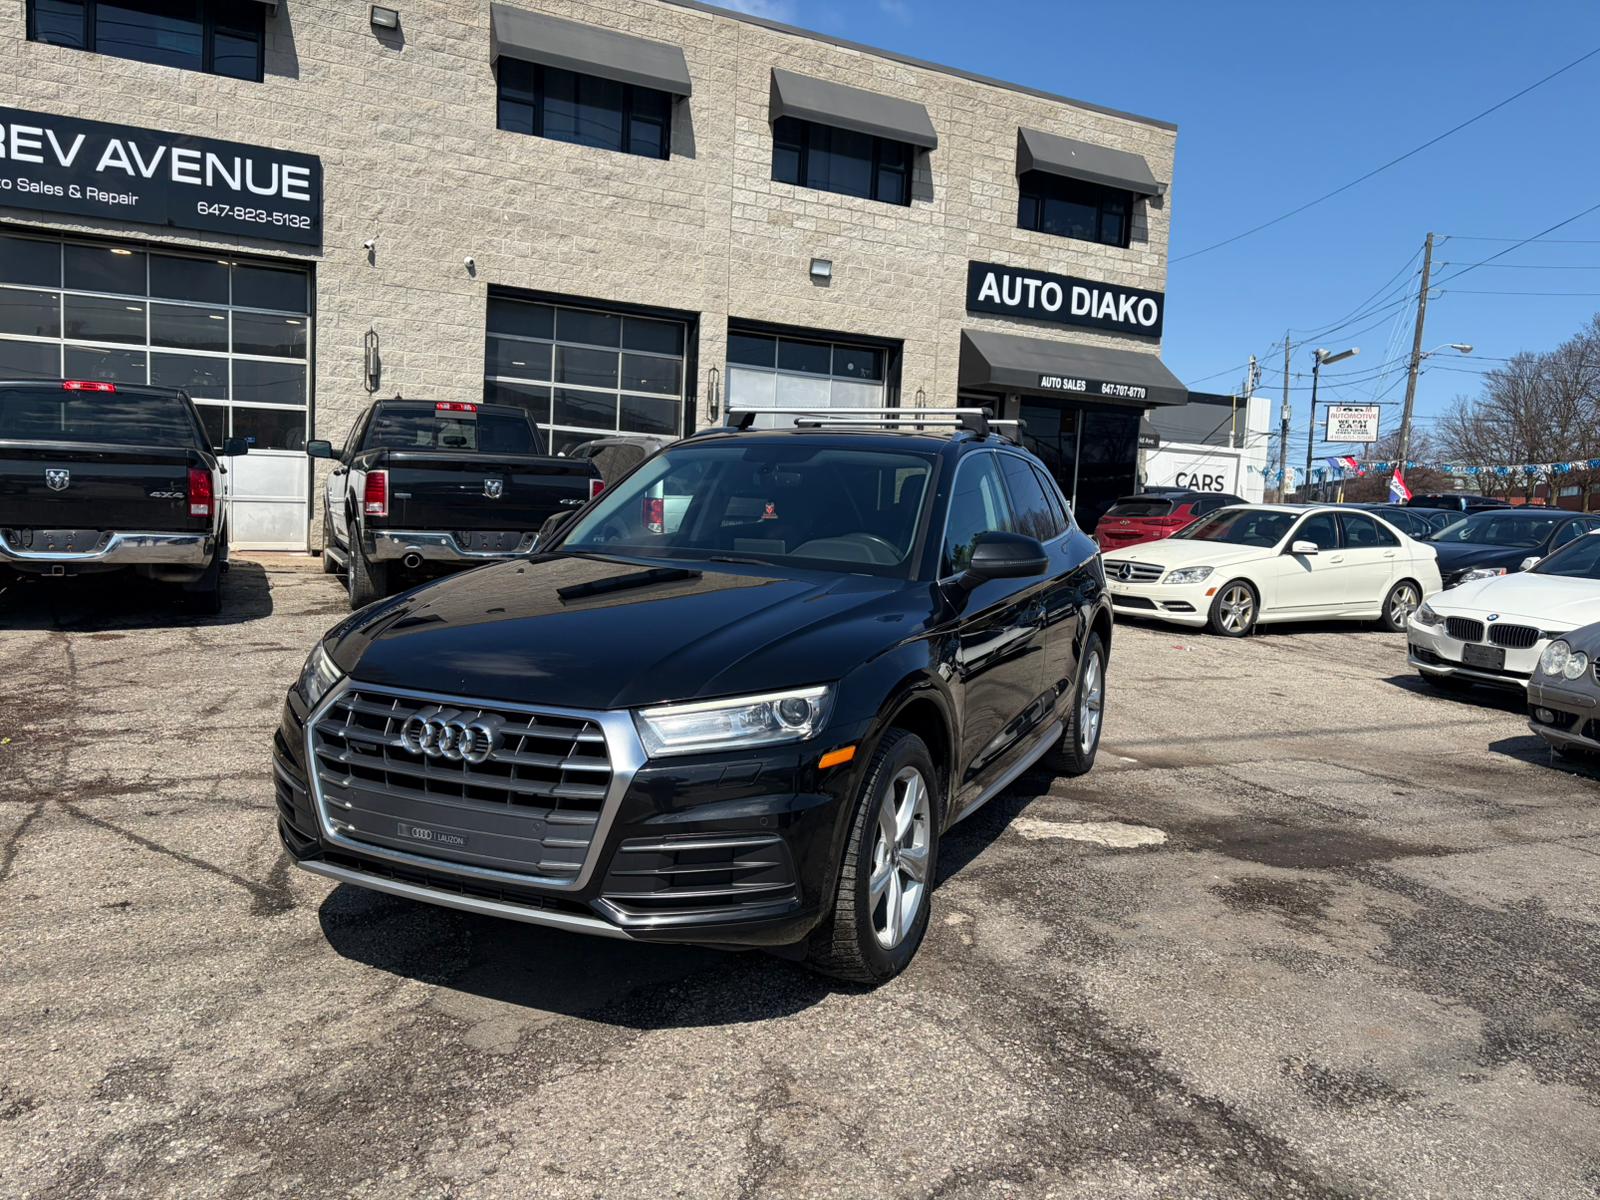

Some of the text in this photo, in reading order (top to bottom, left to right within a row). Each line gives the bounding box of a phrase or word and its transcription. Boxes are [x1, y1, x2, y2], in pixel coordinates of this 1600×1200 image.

[0, 122, 311, 201] EV AVENUE
[16, 178, 64, 198] Sales
[68, 185, 83, 199] &
[86, 186, 140, 206] Repair
[197, 201, 311, 230] 647-823-5132
[977, 272, 1159, 327] AUTO DIAKO
[1040, 376, 1146, 398] AUTO SALES 647-707-8770
[1330, 412, 1377, 420] AUTOMOTIVE
[1175, 472, 1225, 492] CARS
